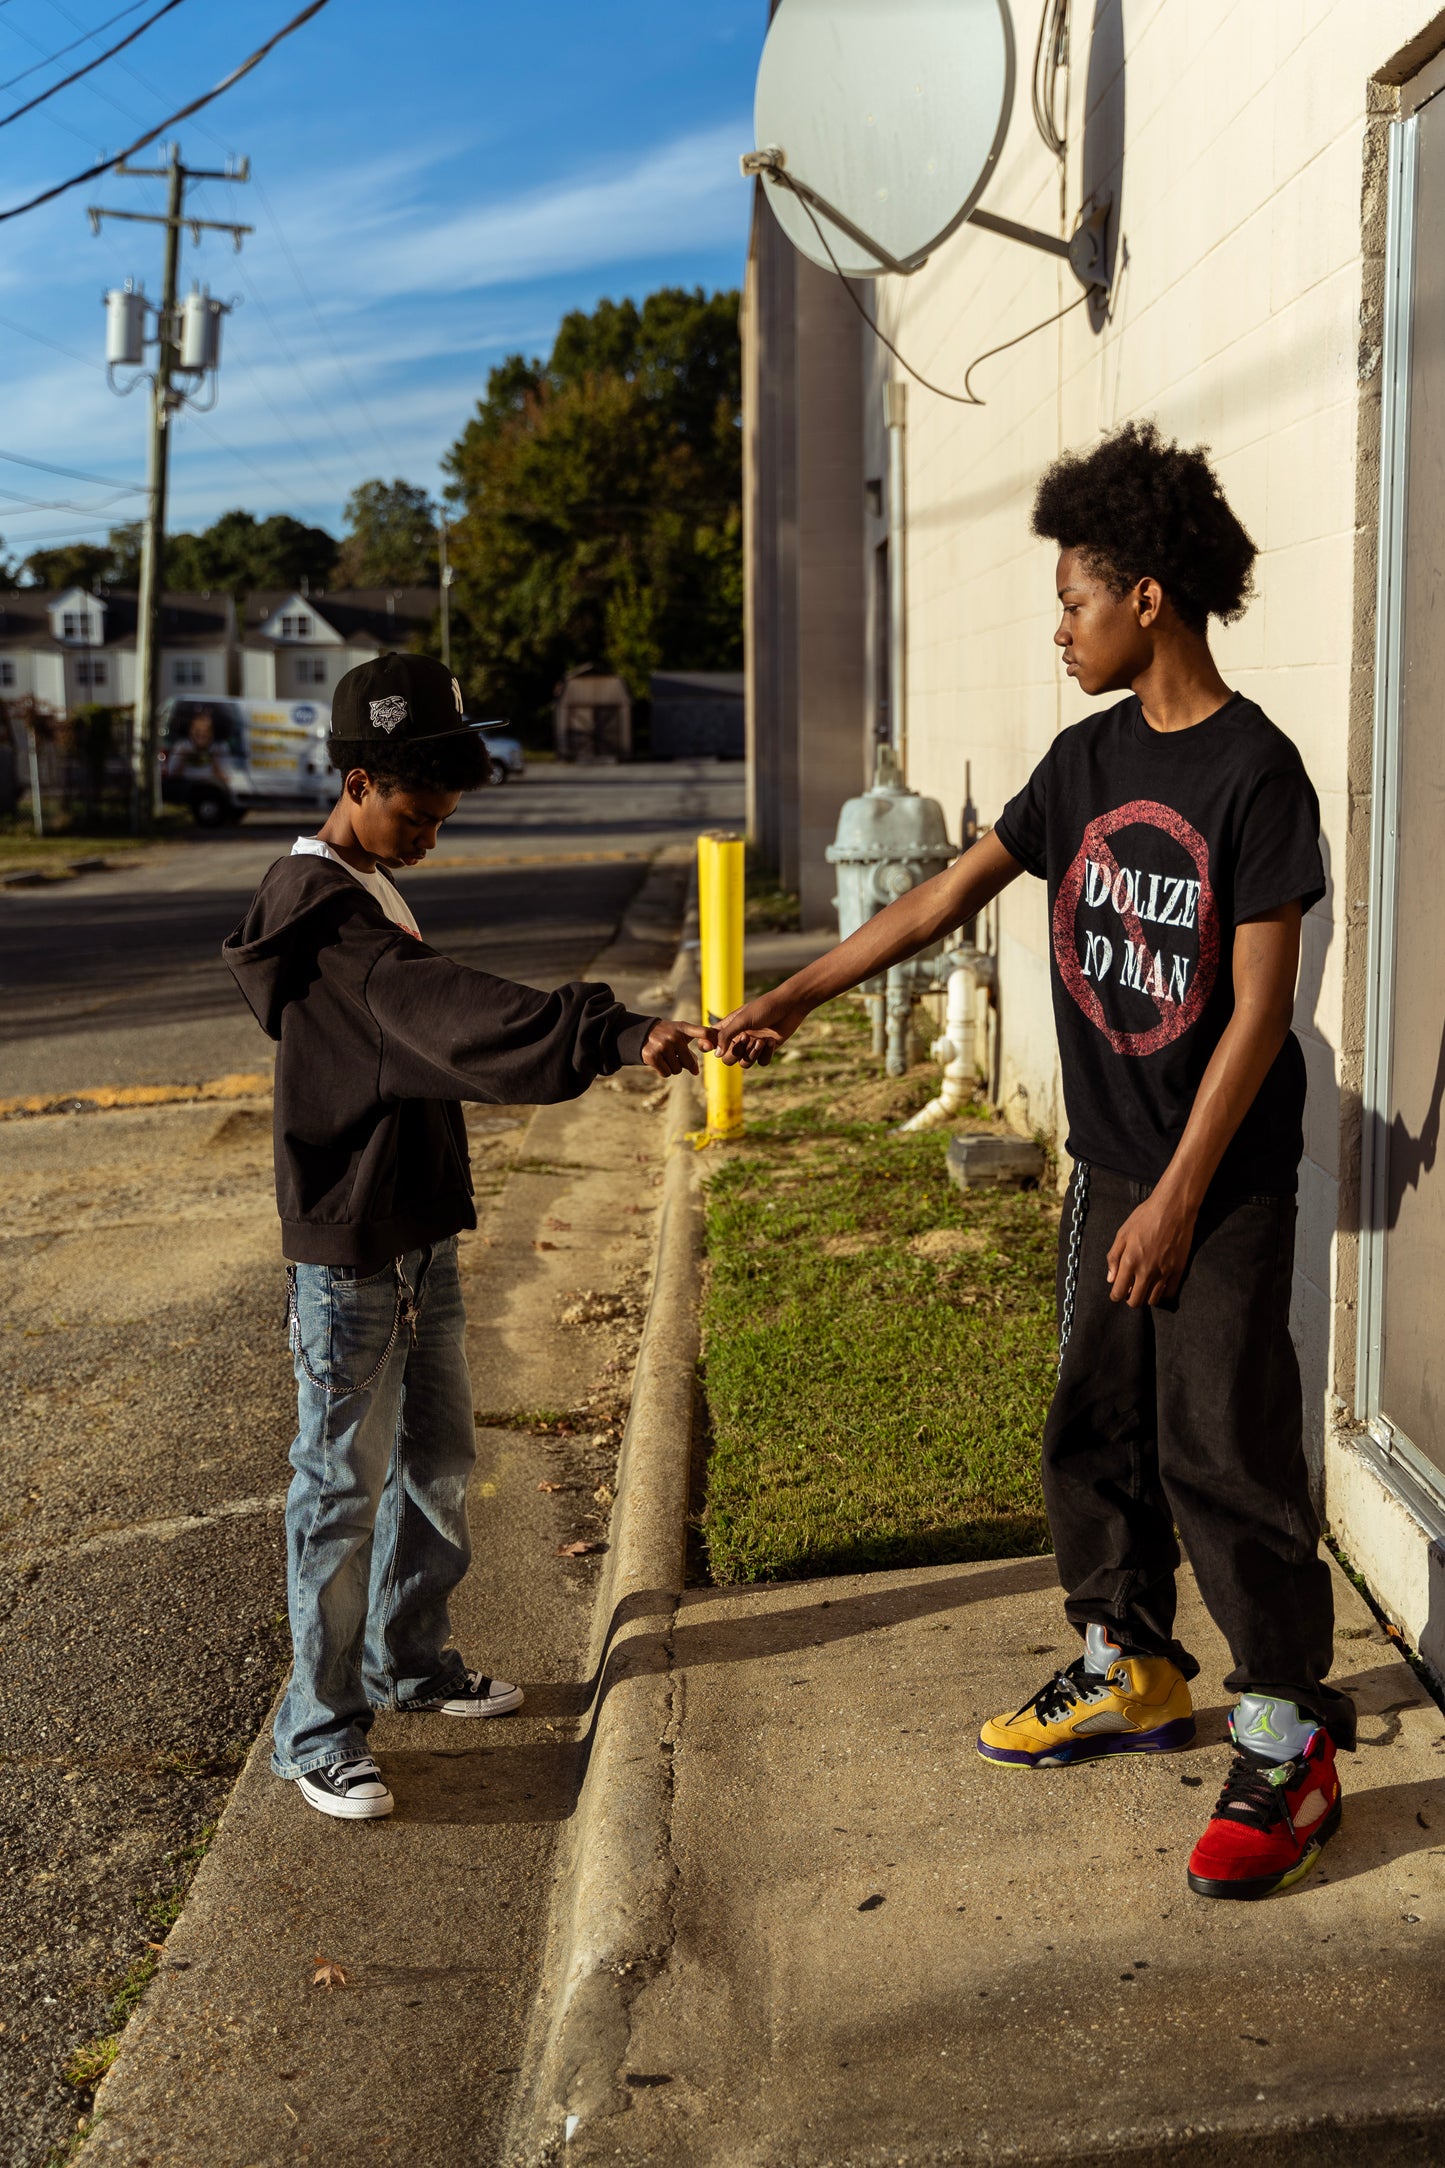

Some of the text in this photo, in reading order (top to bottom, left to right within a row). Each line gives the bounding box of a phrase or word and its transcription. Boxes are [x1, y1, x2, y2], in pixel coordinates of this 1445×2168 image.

[1085, 858, 1201, 929] IDOLIZE
[1080, 929, 1190, 1004] NO MAN
